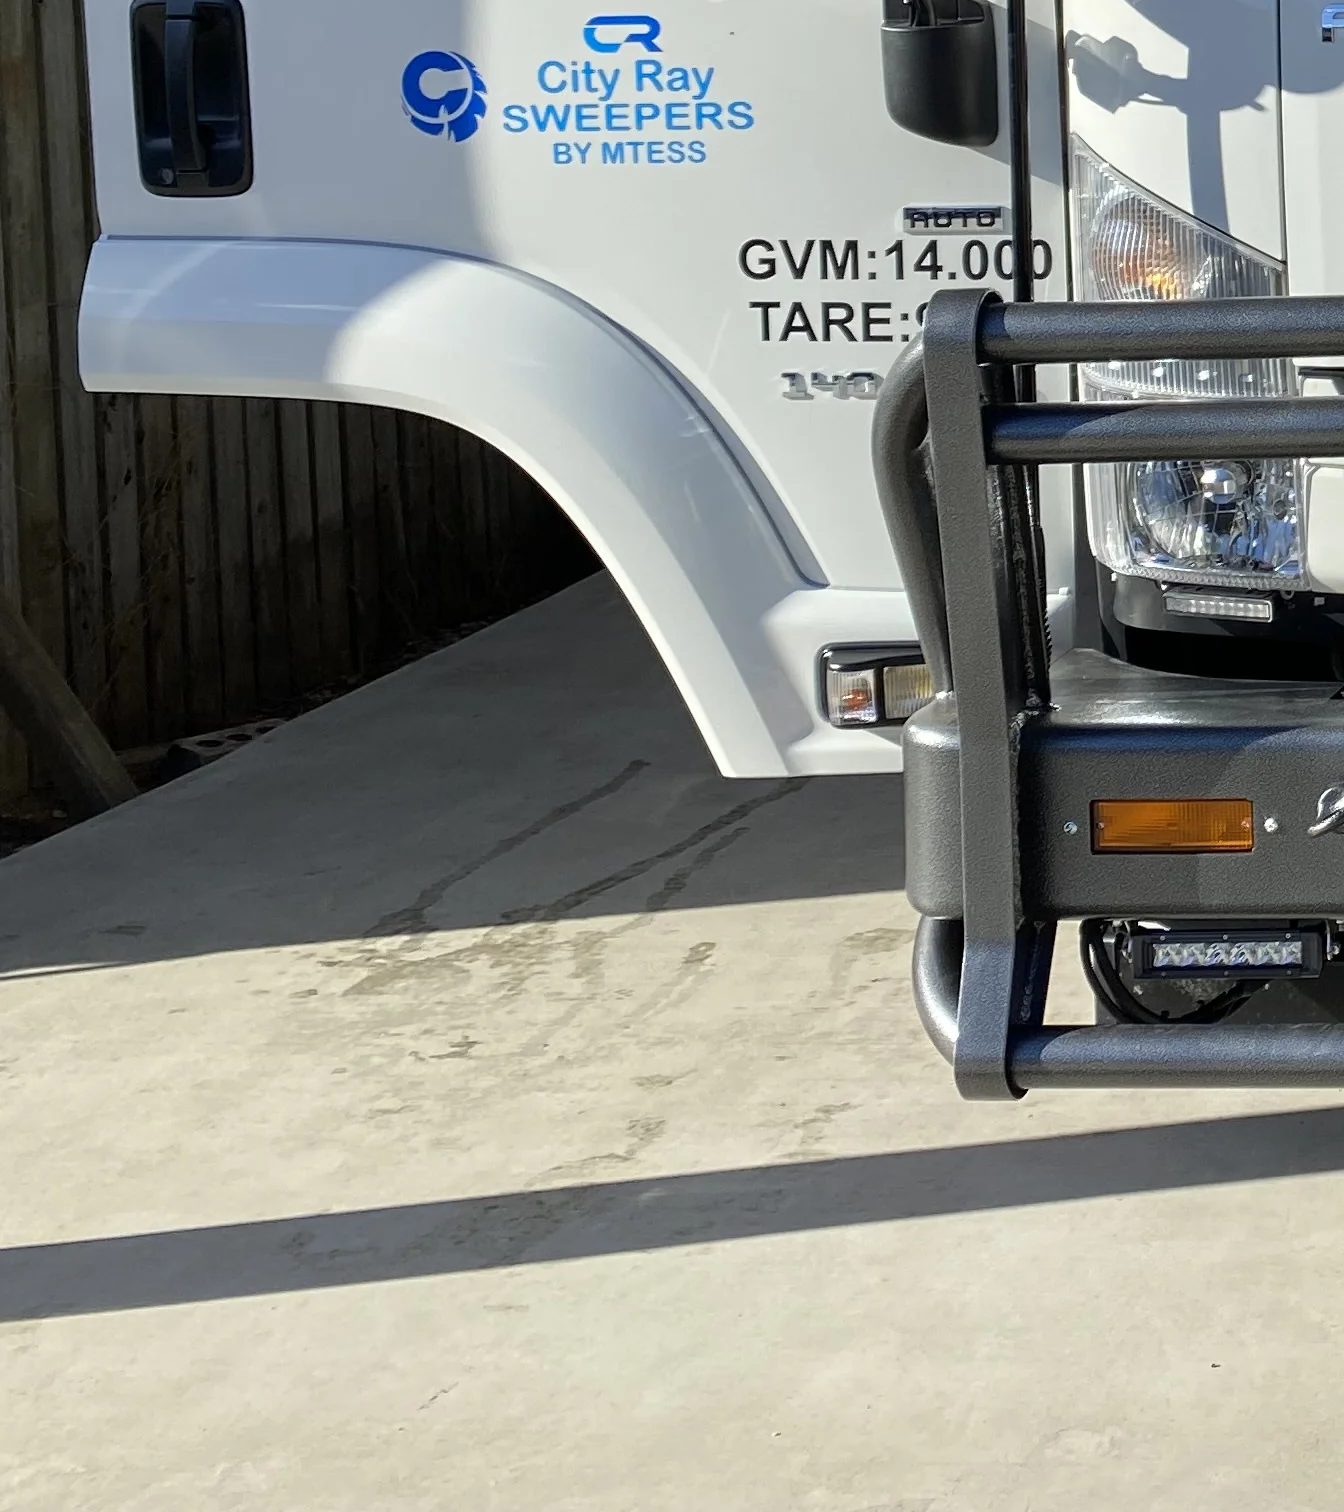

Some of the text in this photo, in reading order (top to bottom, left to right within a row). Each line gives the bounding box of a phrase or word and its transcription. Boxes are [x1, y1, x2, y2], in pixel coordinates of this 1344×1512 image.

[537, 59, 715, 102] City Ray
[502, 101, 755, 133] SWEEPERS
[553, 141, 707, 165] BY MTESS
[909, 211, 996, 229] AUTO
[738, 239, 1052, 281] GVM:14.000
[749, 301, 925, 342] TARE:
